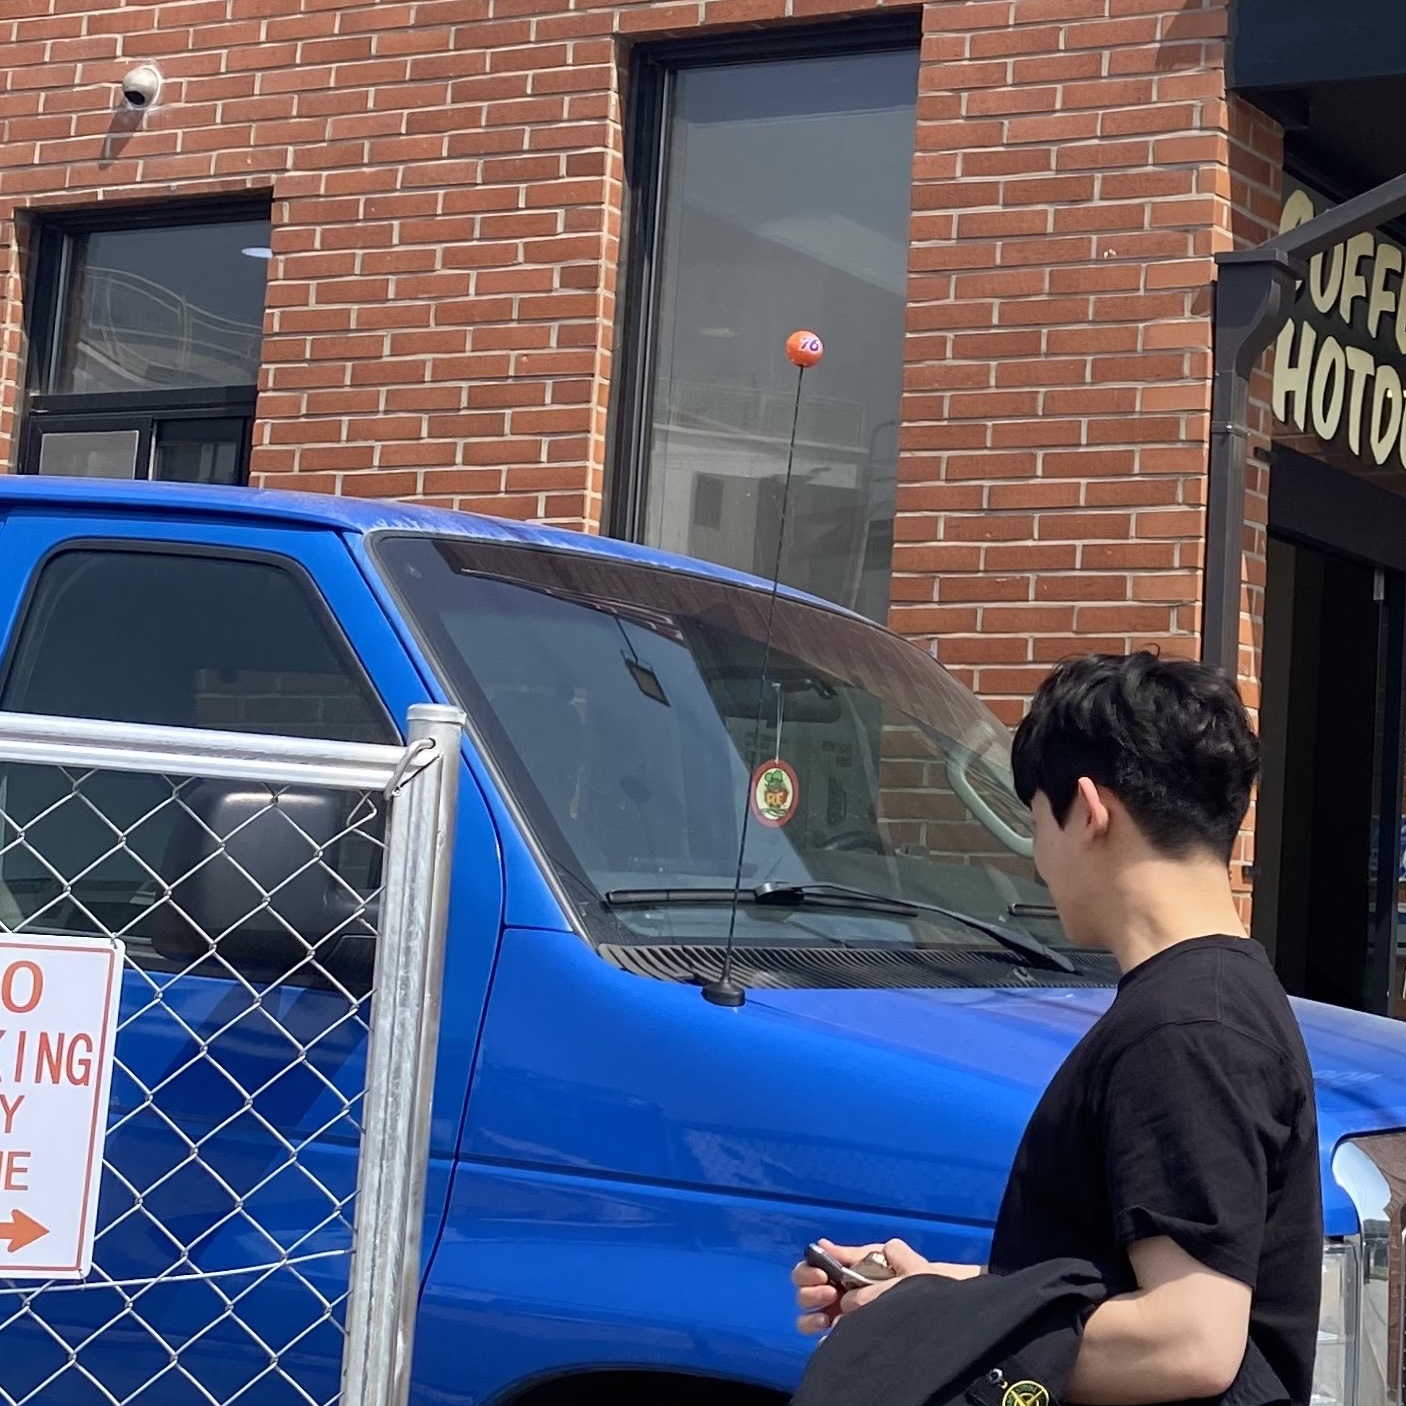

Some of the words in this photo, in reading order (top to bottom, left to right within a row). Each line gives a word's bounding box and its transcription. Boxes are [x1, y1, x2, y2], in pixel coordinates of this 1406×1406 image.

[801, 337, 819, 351] 76
[766, 790, 787, 807] RF
[0, 1030, 93, 1086] ING
[0, 1151, 31, 1191] E
